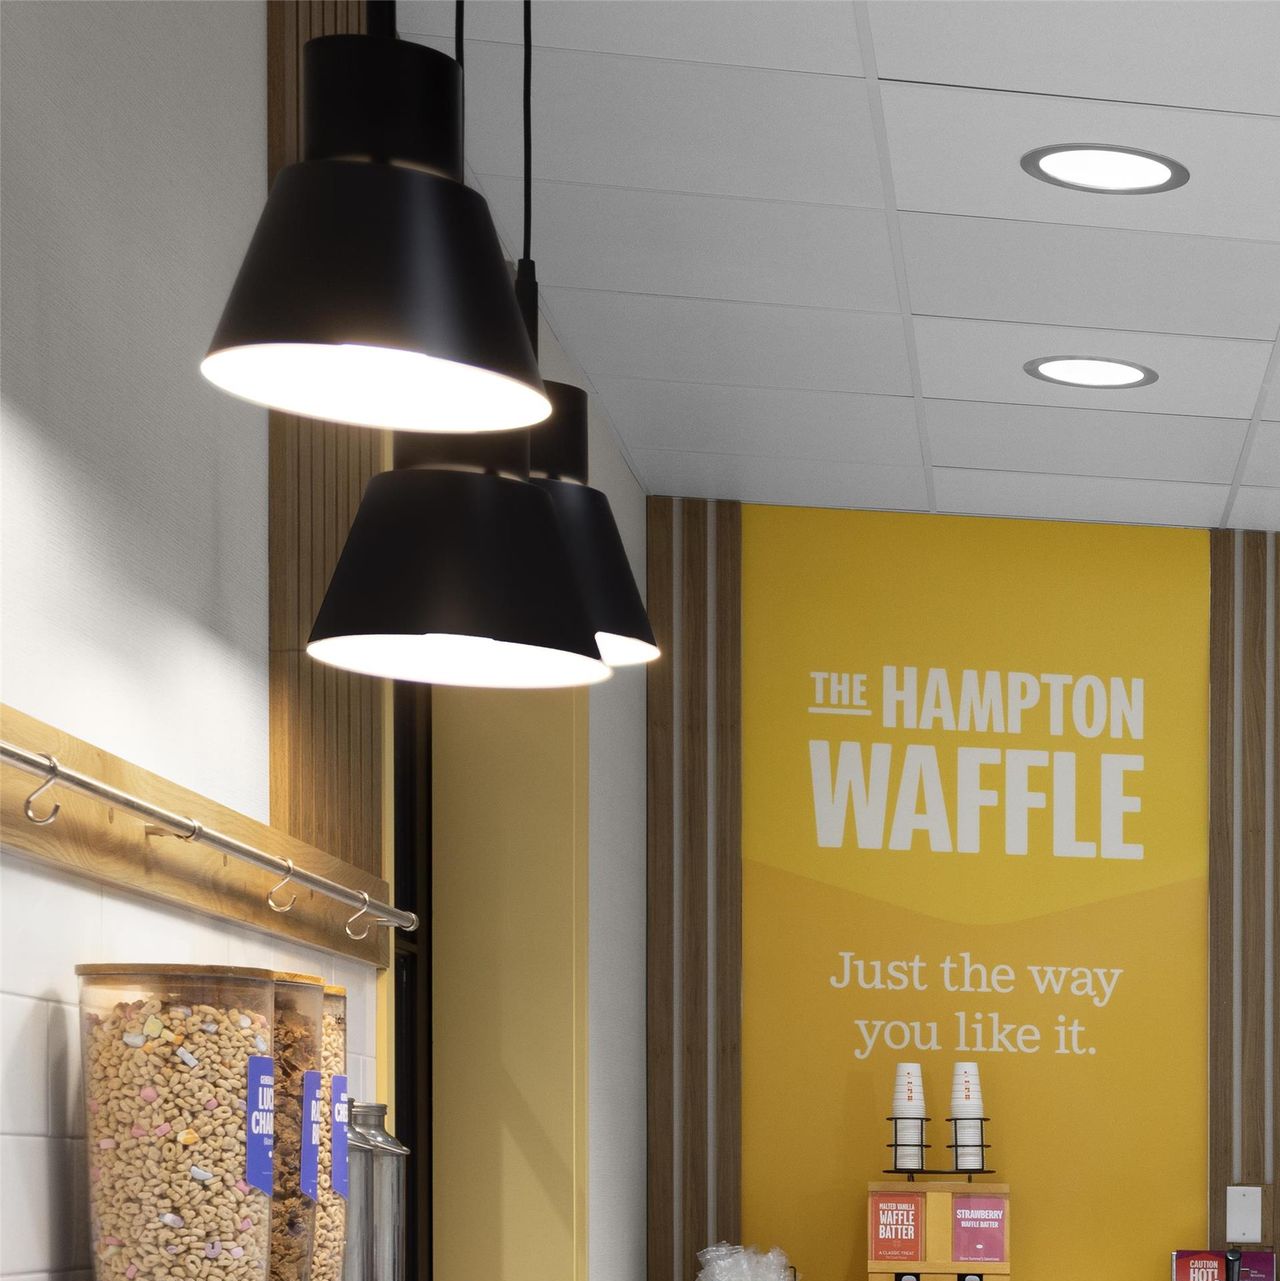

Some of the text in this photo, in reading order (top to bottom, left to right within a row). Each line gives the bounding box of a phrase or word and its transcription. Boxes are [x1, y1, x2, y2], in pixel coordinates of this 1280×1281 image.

[809, 665, 1144, 740] THE HAMPTON
[808, 739, 1144, 860] WAFFLE
[829, 951, 1124, 1008] Just the way
[853, 1012, 1098, 1060] you like it.
[897, 1203, 915, 1211] VANILLA
[956, 1209, 1003, 1220] STRAWBERRY
[879, 1210, 915, 1225] WAFFLE
[961, 1220, 980, 1228] WAFFLE
[879, 1225, 915, 1240] BATTER
[1189, 1260, 1218, 1269] CAUTION
